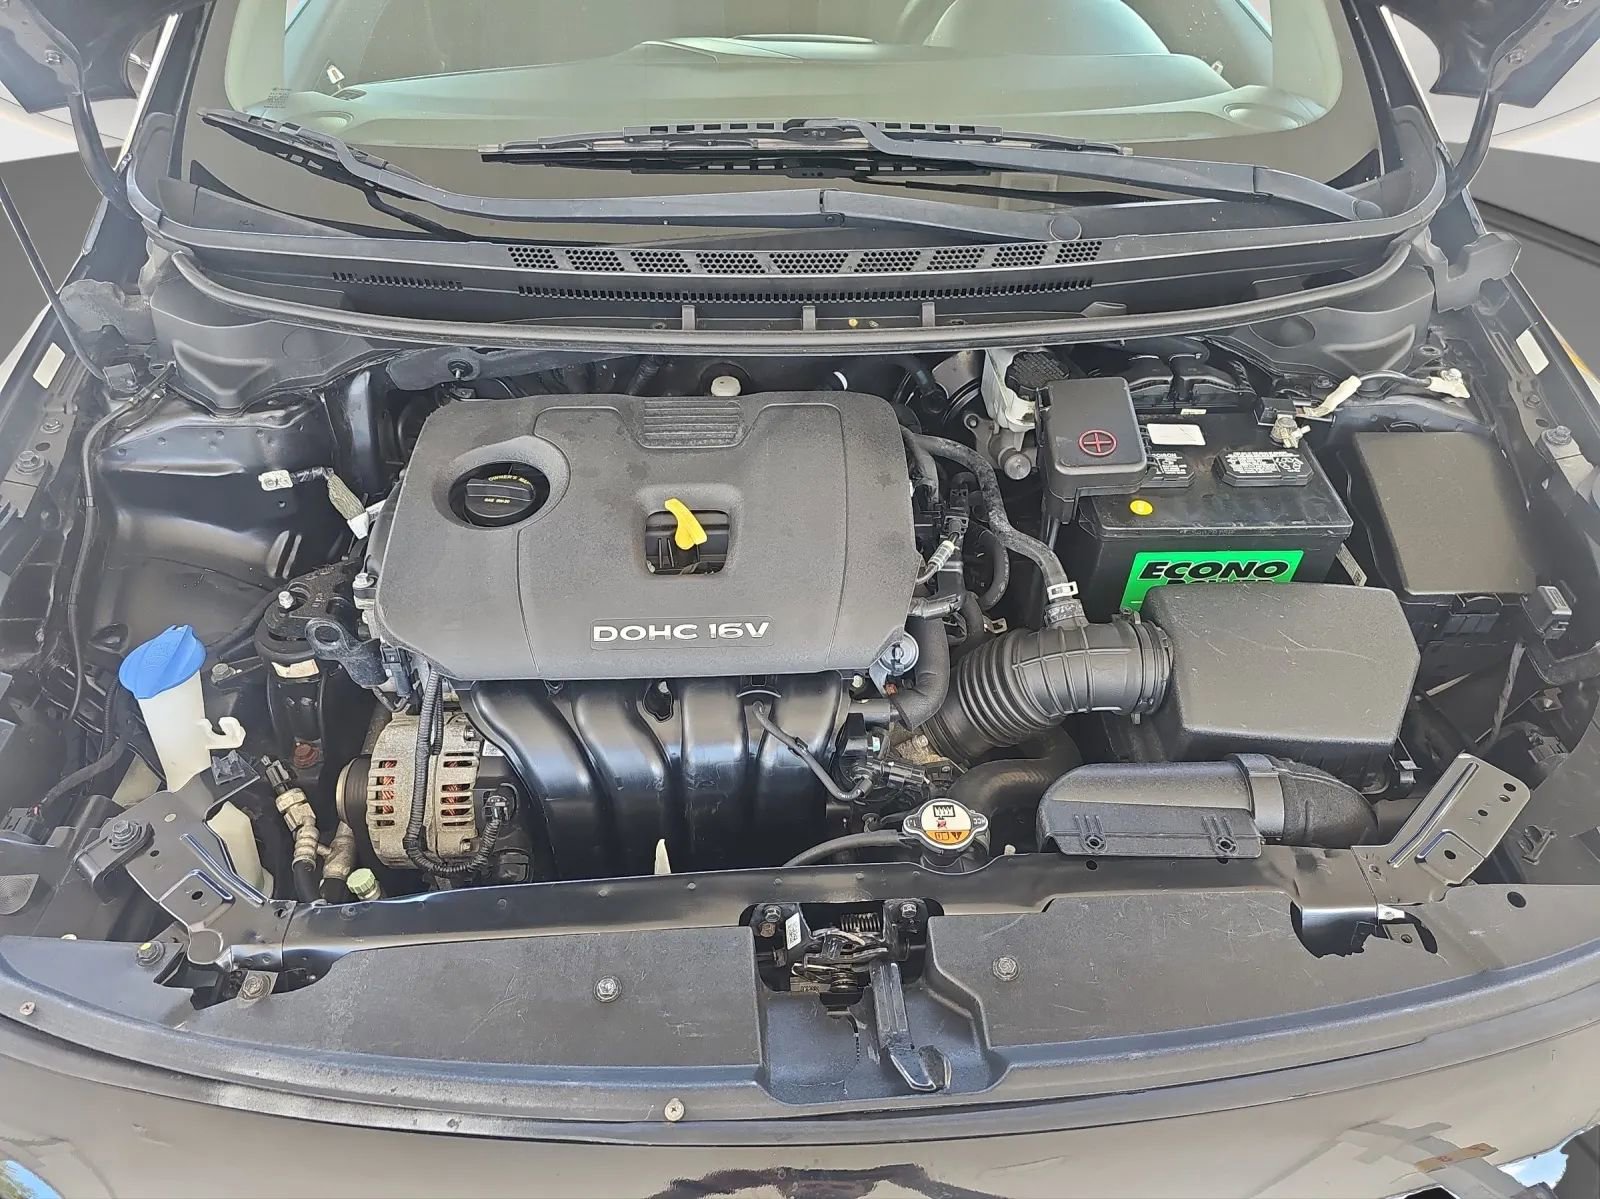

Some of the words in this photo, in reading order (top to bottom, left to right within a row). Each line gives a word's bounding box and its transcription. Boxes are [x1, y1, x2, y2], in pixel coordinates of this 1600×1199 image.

[1138, 561, 1290, 580] ECONO
[593, 624, 699, 642] DOHC
[709, 622, 770, 639] 16V
